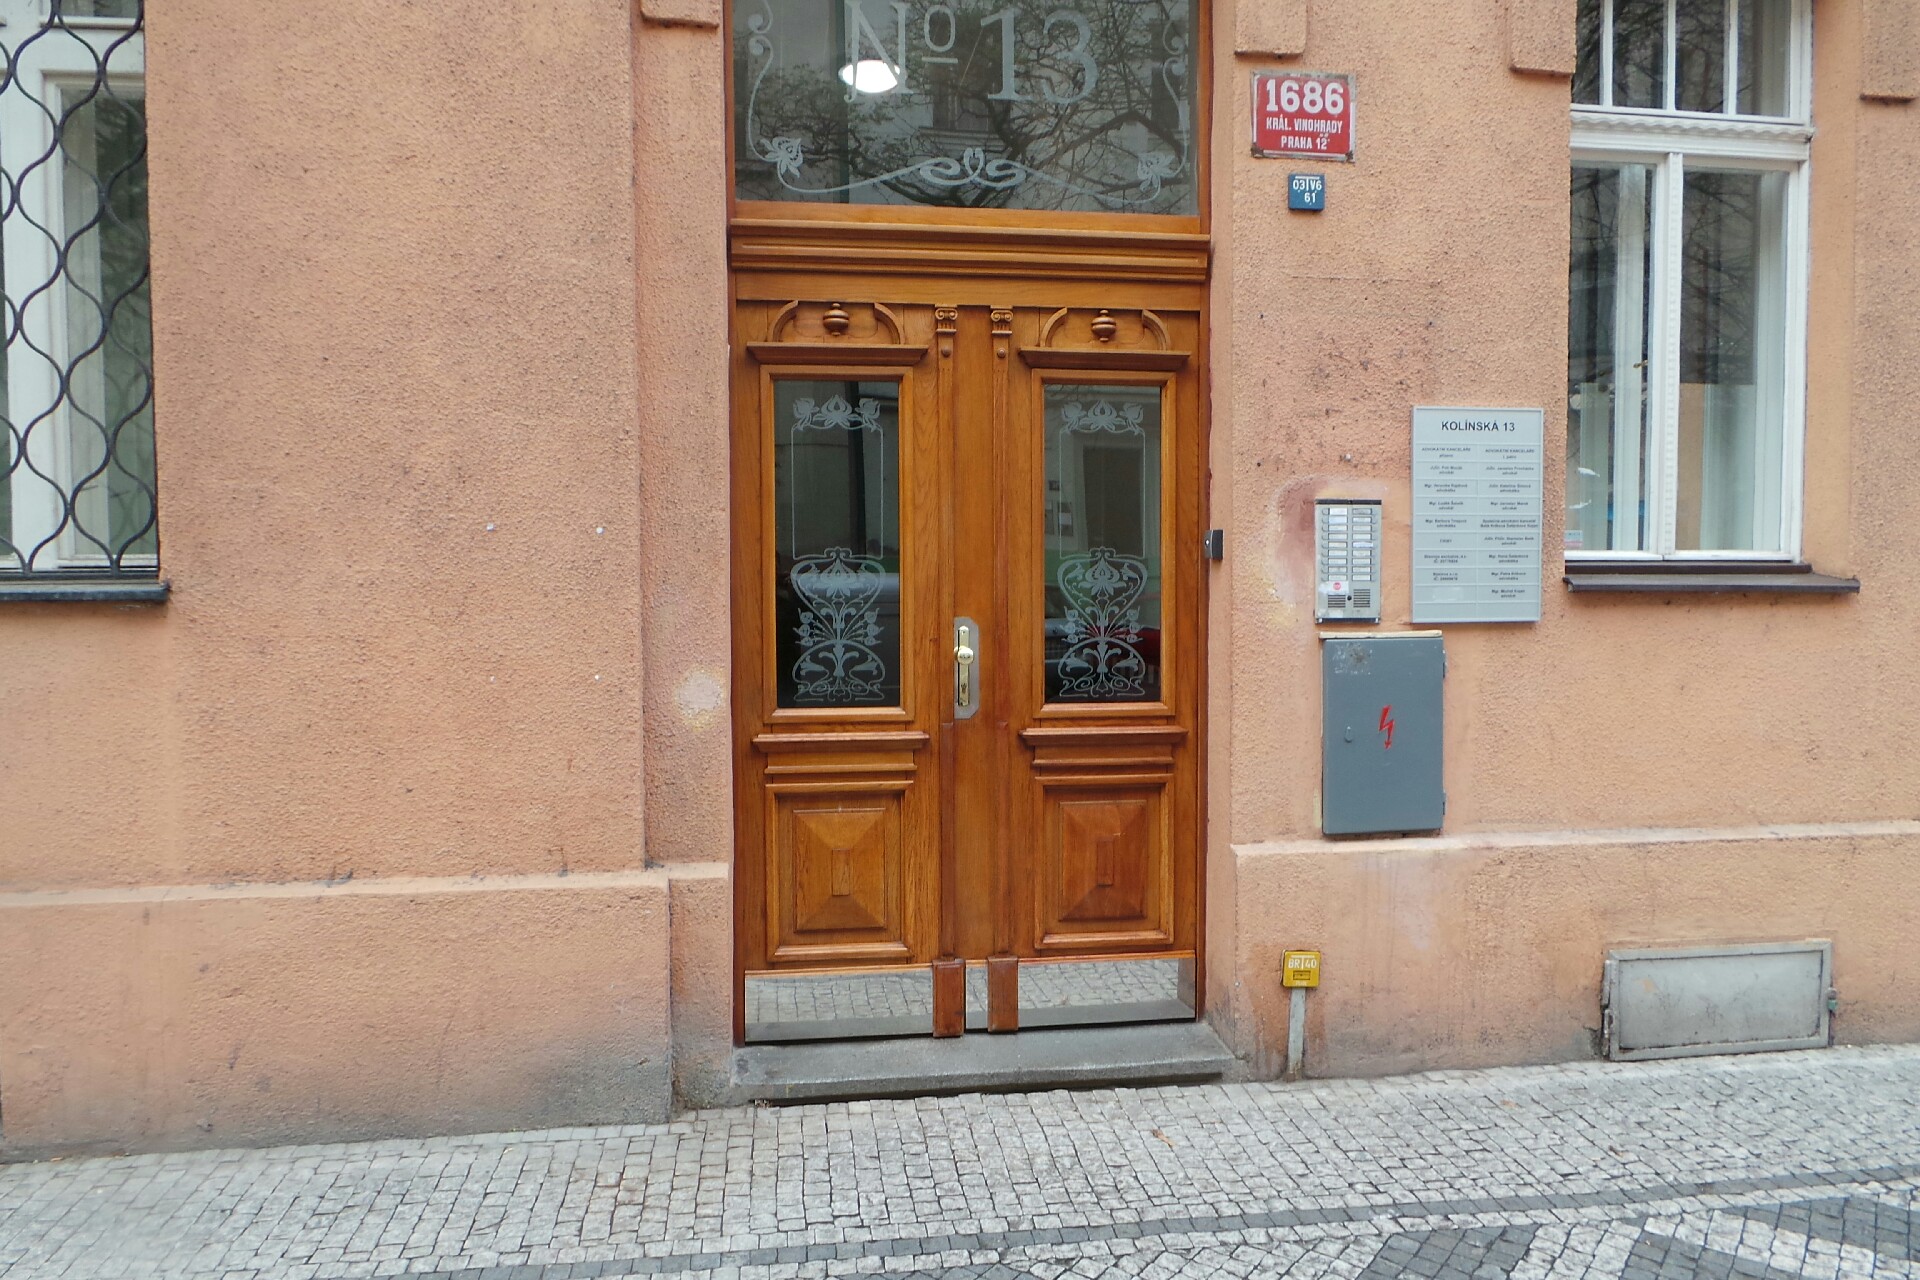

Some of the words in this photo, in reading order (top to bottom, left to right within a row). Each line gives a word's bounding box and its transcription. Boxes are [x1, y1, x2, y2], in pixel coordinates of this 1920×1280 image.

[980, 7, 1099, 104] 13
[1266, 79, 1344, 115] 1686
[1266, 113, 1292, 131] KRÁL.
[1294, 118, 1343, 134] VINOHRADY
[1281, 135, 1313, 149] PRAHA
[1441, 419, 1499, 431] KOLÍNSKÁ
[1503, 422, 1515, 432] 13
